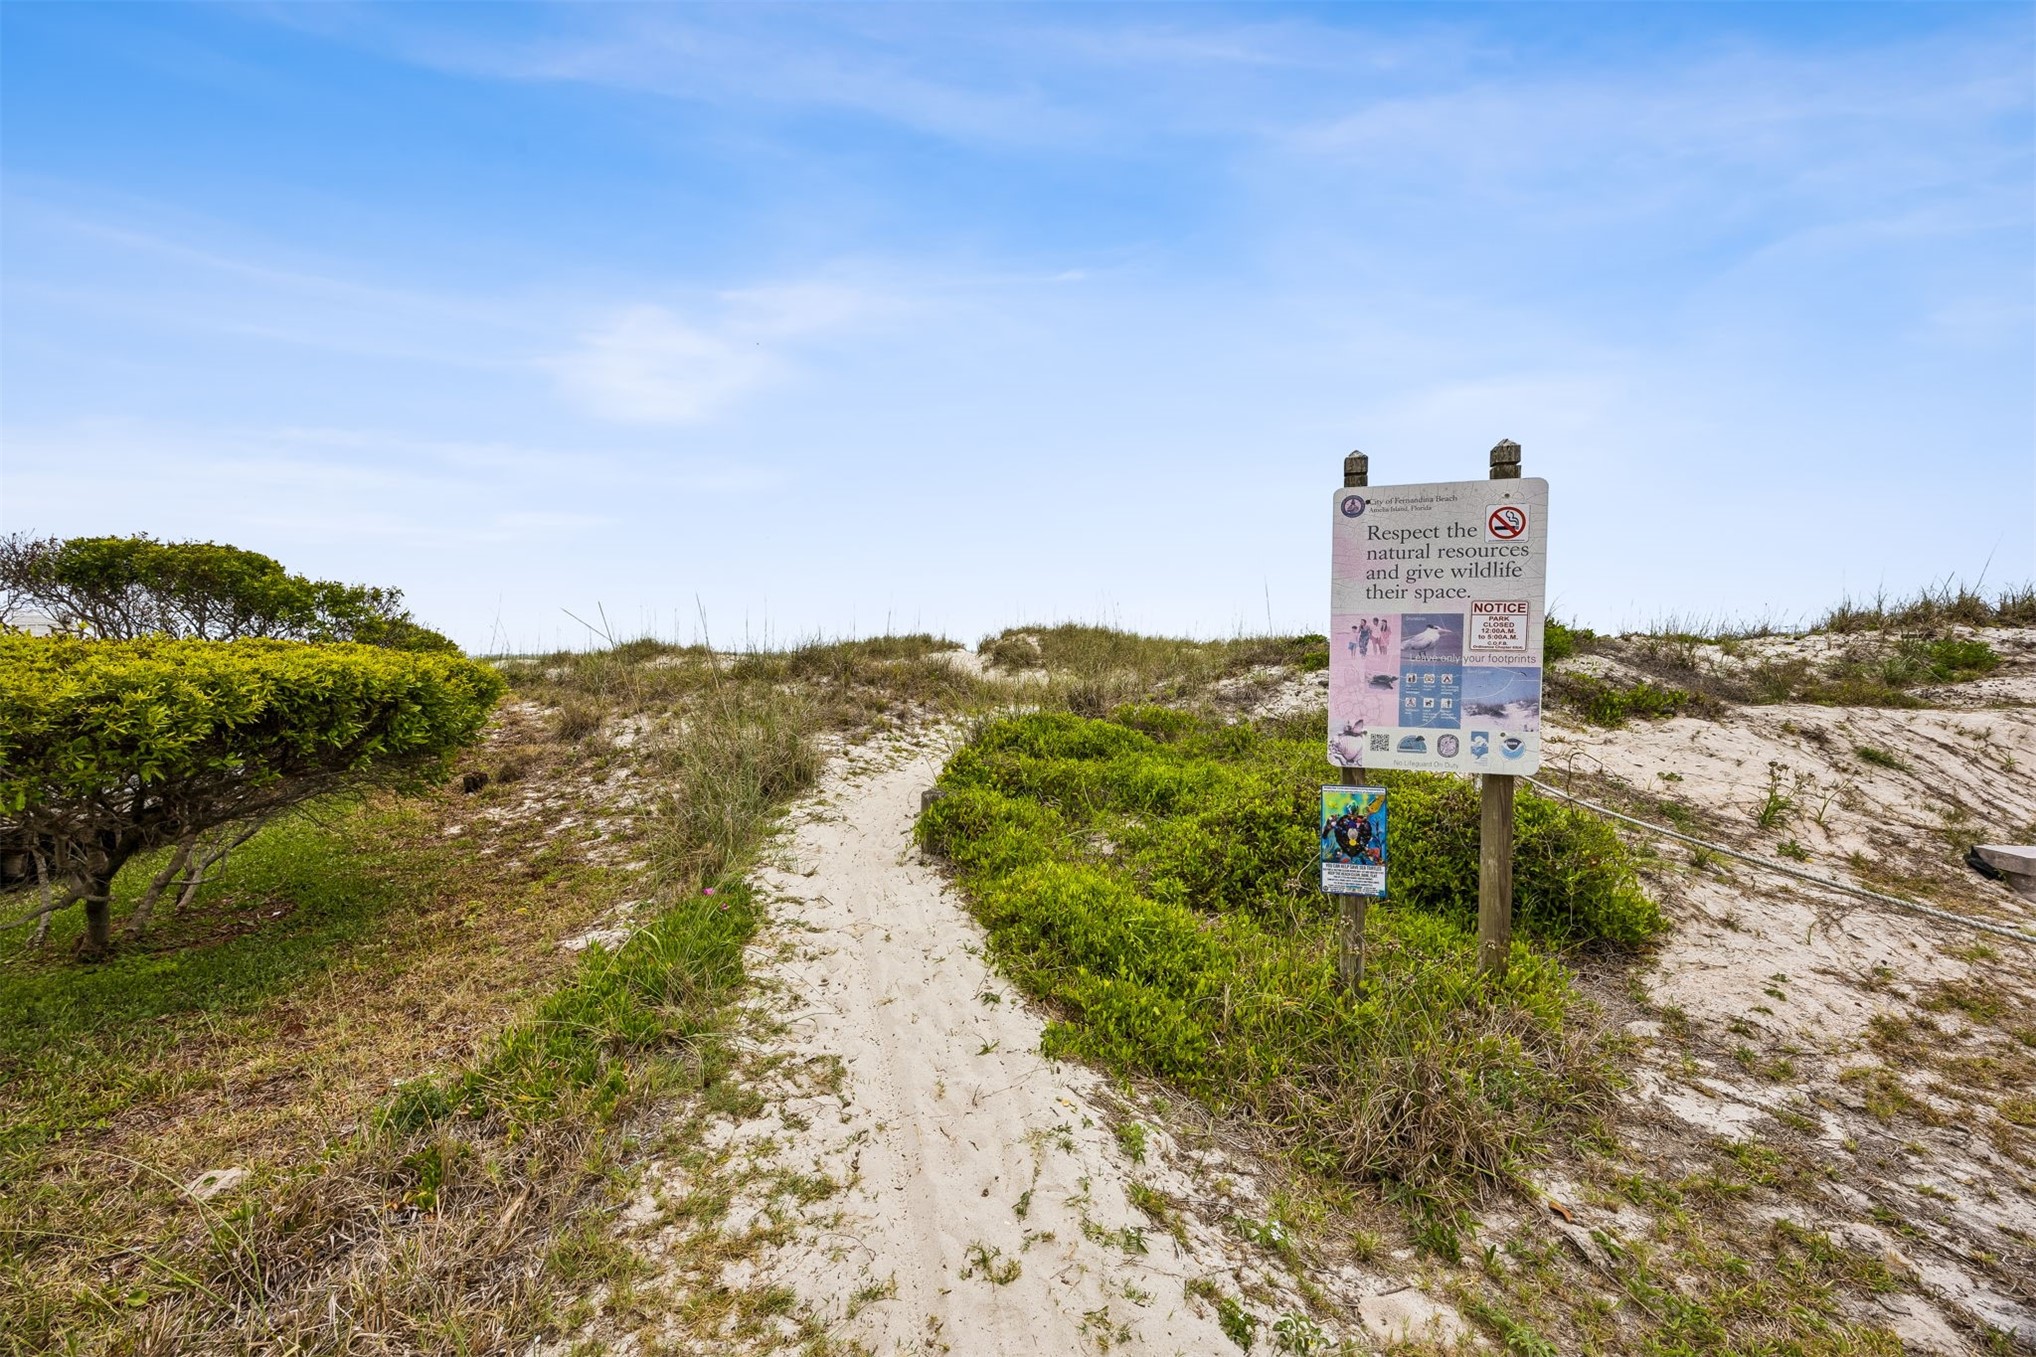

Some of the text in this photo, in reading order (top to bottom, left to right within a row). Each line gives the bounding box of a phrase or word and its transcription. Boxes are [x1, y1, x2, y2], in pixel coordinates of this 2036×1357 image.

[1367, 522, 1478, 544] Respect the
[1366, 543, 1529, 561] natural resources
[1366, 561, 1522, 584] and give wildlife
[1366, 584, 1471, 603] their space.
[1474, 603, 1526, 613] NOTICE
[1440, 653, 1460, 664] only
[1463, 655, 1484, 664] your
[1488, 653, 1537, 665] footprints
